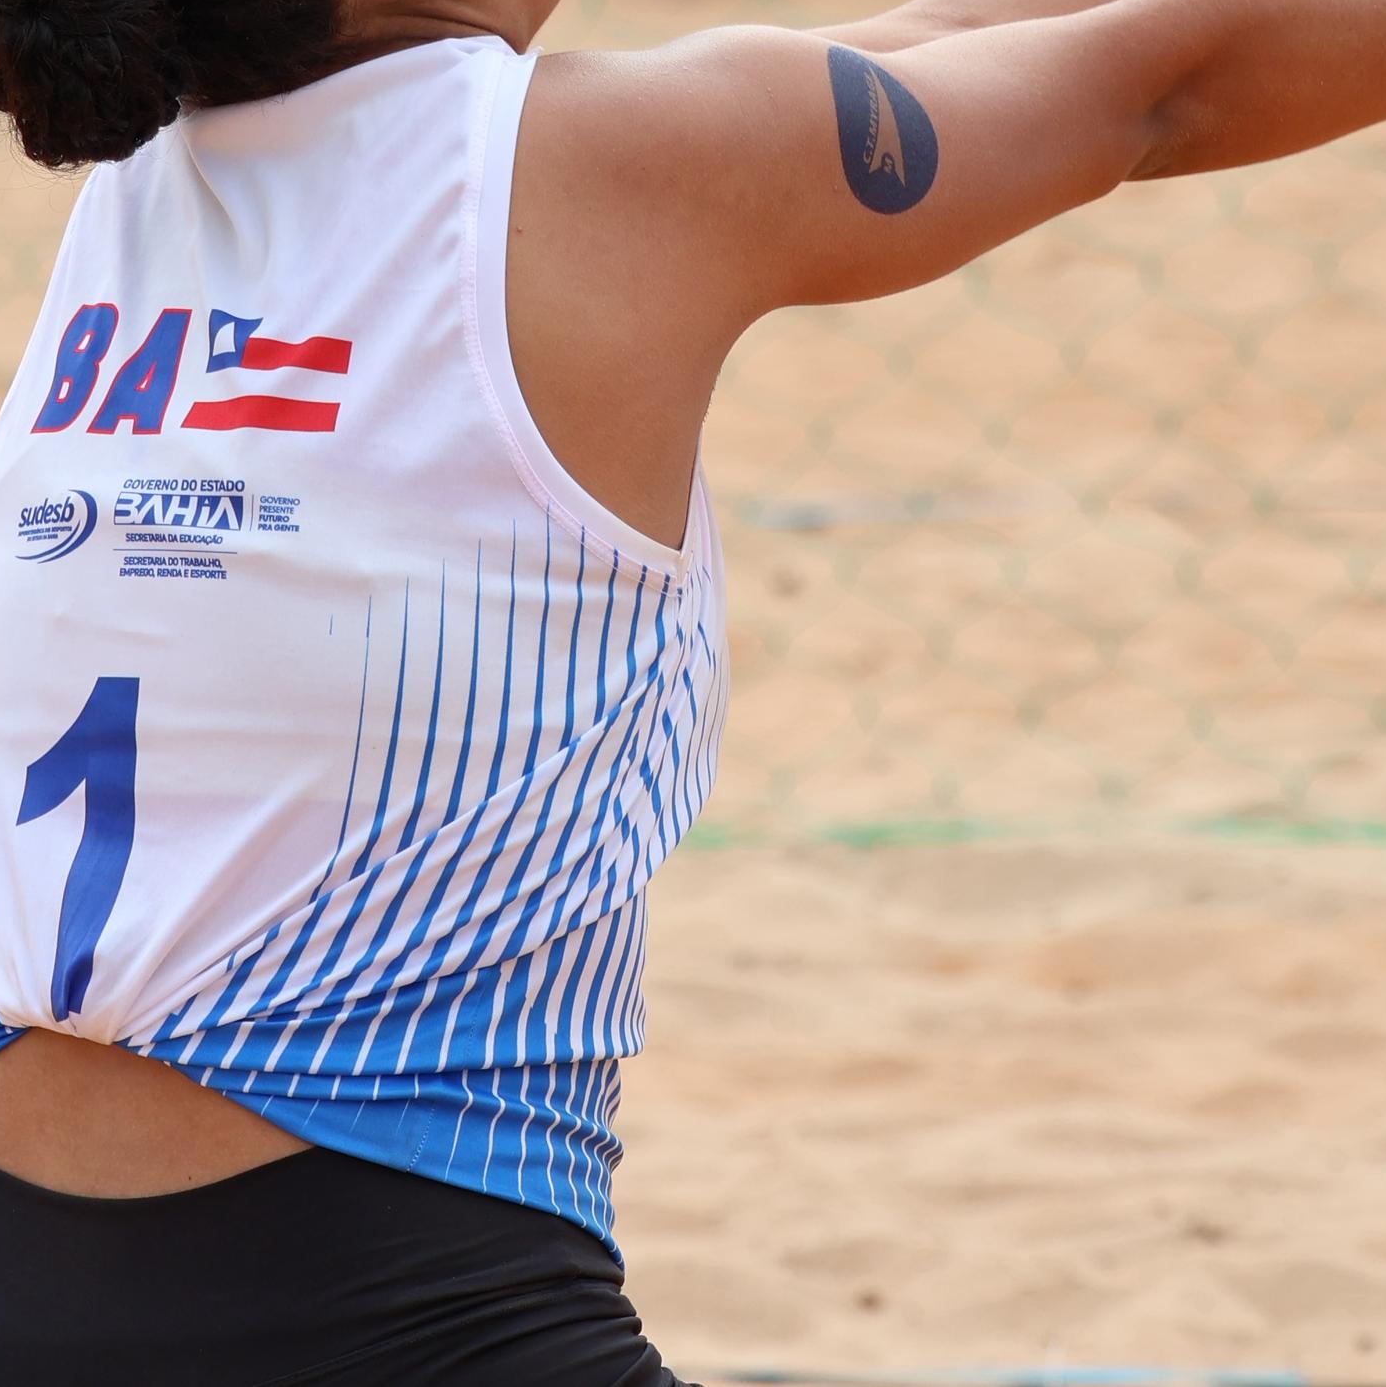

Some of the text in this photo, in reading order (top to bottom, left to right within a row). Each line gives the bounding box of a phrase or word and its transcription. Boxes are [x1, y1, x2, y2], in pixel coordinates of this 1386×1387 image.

[30, 302, 193, 435] BA
[123, 479, 245, 492] GOVERNO DO ESTADO
[259, 495, 301, 506] GOVERNO
[18, 496, 75, 527] sudesb
[259, 505, 295, 514] PRESENTE
[258, 514, 290, 523] FUTURO
[257, 523, 300, 532] PRA GENTE
[125, 533, 223, 545] SECRETARIA DA EDUCAÇÃO
[123, 556, 223, 568] SECRETARIA DO TRABALHO,
[157, 568, 182, 577] RENDA
[184, 569, 190, 578] E
[191, 569, 227, 579] ESPORTE
[16, 677, 140, 1022] 1
